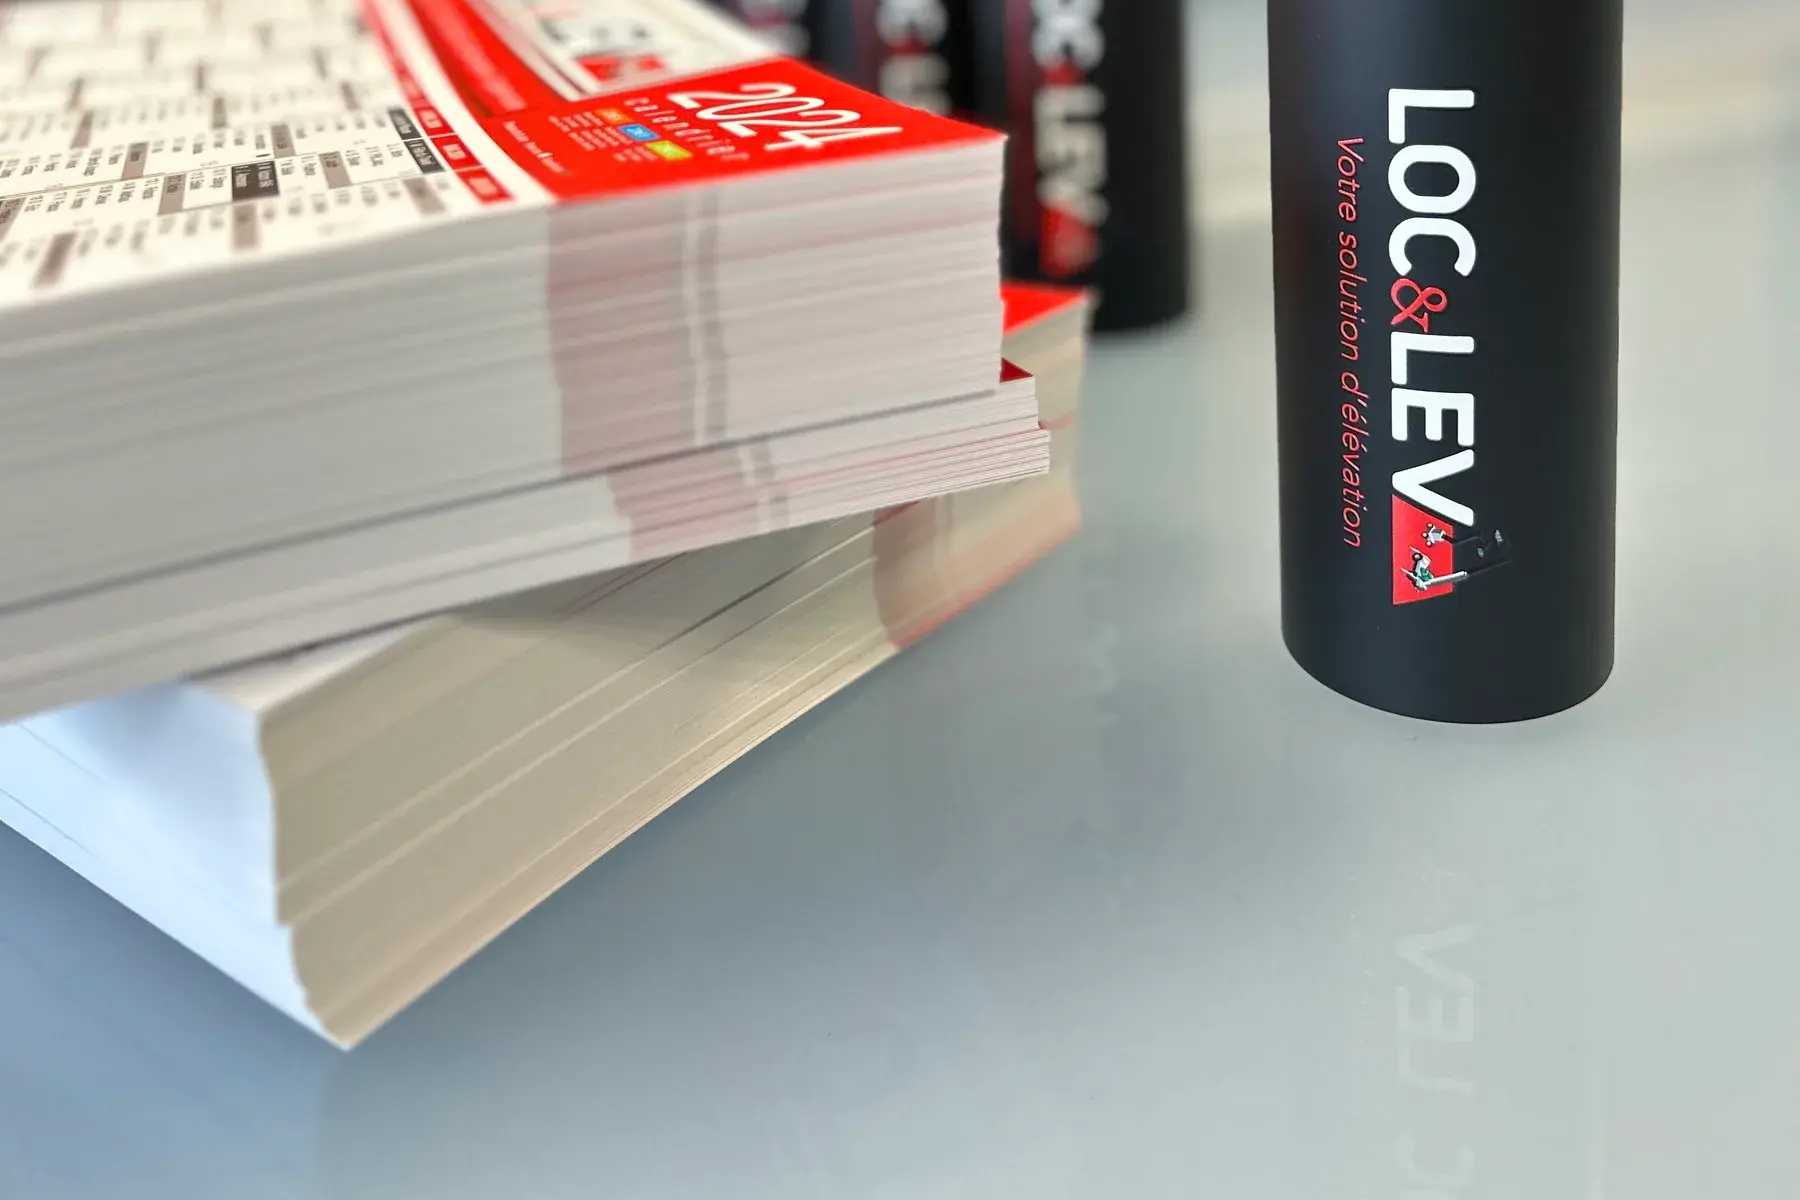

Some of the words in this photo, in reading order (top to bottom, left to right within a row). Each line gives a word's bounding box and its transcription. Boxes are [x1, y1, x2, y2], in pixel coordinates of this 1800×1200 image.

[622, 96, 750, 162] calendrier
[666, 82, 904, 151] 2024
[1336, 137, 1364, 223] Votre
[1338, 230, 1368, 362] solution
[1387, 87, 1477, 527] LOC&LEV
[1340, 370, 1371, 549] d'élévation
